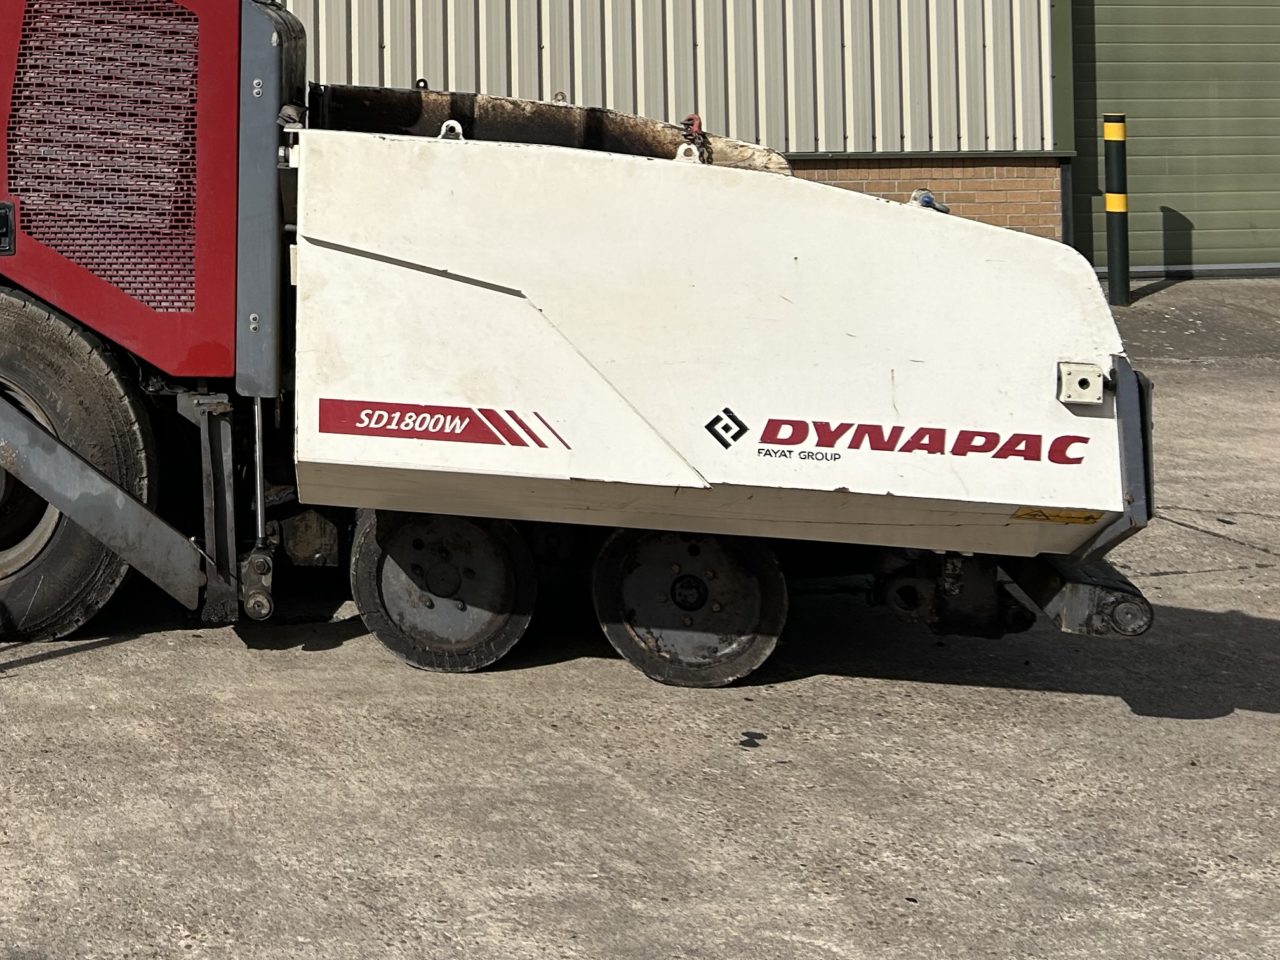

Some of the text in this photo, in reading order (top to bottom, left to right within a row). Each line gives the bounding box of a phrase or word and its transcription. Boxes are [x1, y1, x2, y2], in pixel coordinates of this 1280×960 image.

[355, 409, 470, 434] SD1800W
[758, 418, 1090, 465] DYNAPAC
[757, 448, 842, 462] FAYAT GROUP
